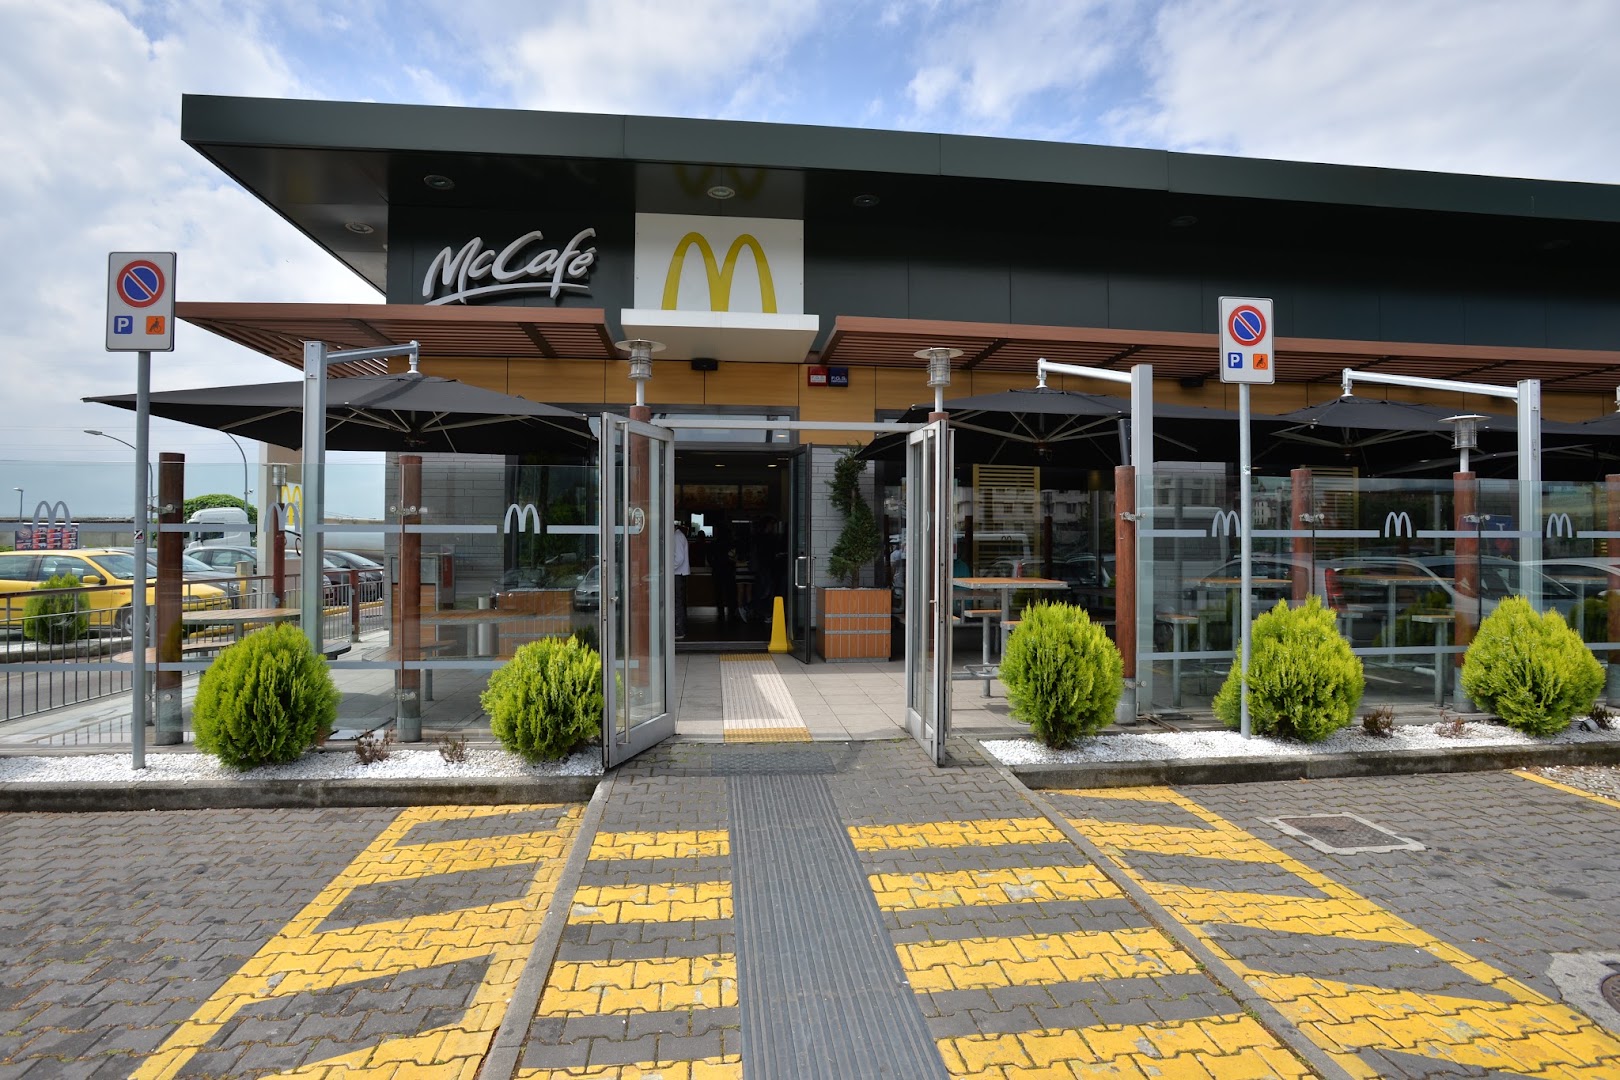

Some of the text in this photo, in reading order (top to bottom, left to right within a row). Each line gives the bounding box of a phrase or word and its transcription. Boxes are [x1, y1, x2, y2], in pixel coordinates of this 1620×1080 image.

[422, 228, 597, 305] McCafé
[117, 317, 129, 333] P
[1230, 353, 1241, 367] P
